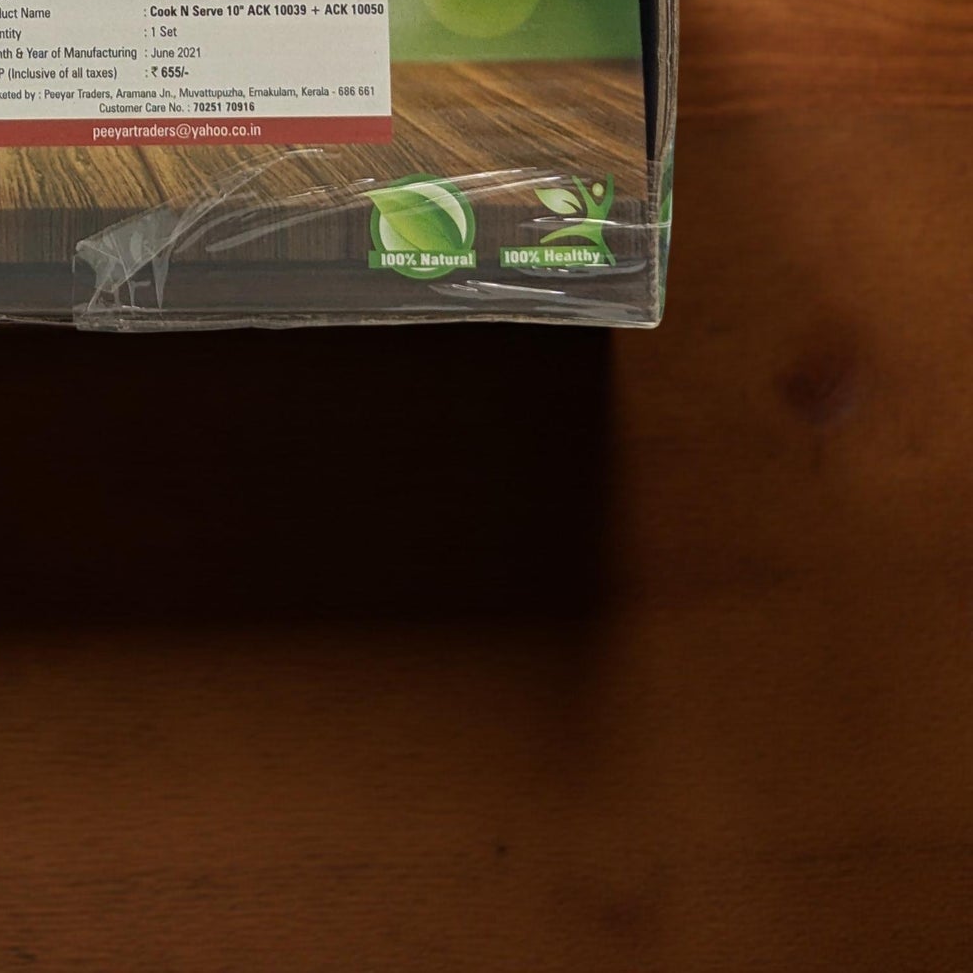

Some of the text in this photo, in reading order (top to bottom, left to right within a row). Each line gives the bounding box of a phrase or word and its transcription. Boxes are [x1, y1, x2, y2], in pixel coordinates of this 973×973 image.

[21, 8, 51, 18] Name
[150, 6, 177, 16] Cook
[181, 6, 189, 16] N
[193, 6, 223, 16] Serve
[227, 5, 244, 15] 10"
[247, 5, 270, 15] ACK
[274, 4, 306, 15] 10039
[324, 4, 347, 15] ACK
[352, 4, 384, 14] 10050
[152, 27, 156, 37] 1
[160, 27, 177, 37] Set
[16, 48, 23, 58] &
[27, 48, 48, 58] Year
[51, 47, 61, 58] of
[64, 47, 137, 60] Manufacturing
[151, 48, 174, 58] June
[177, 48, 201, 58] 2021
[8, 68, 56, 80] (Inclusive
[59, 67, 69, 78] of
[72, 67, 83, 78] all
[86, 67, 117, 79] taxes)
[161, 66, 189, 78] 655/-
[24, 90, 35, 101] by
[44, 90, 75, 100] Peeyar
[77, 89, 112, 100] Traders,
[116, 89, 156, 98] Aramana
[159, 89, 176, 99] Jn.,
[179, 87, 246, 99] Muvattupuzha,
[302, 87, 329, 96] Kerala
[338, 87, 355, 96] 686
[359, 86, 375, 96] 661
[99, 103, 142, 113] Customer
[145, 103, 166, 112] Care
[169, 103, 184, 112] No.
[194, 103, 221, 112] 70251
[226, 102, 255, 111] 70916
[93, 122, 262, 140] peeyartraders@yahoo.co.in
[381, 253, 473, 267] 100% Natural
[504, 249, 600, 264] 100% Healthy
